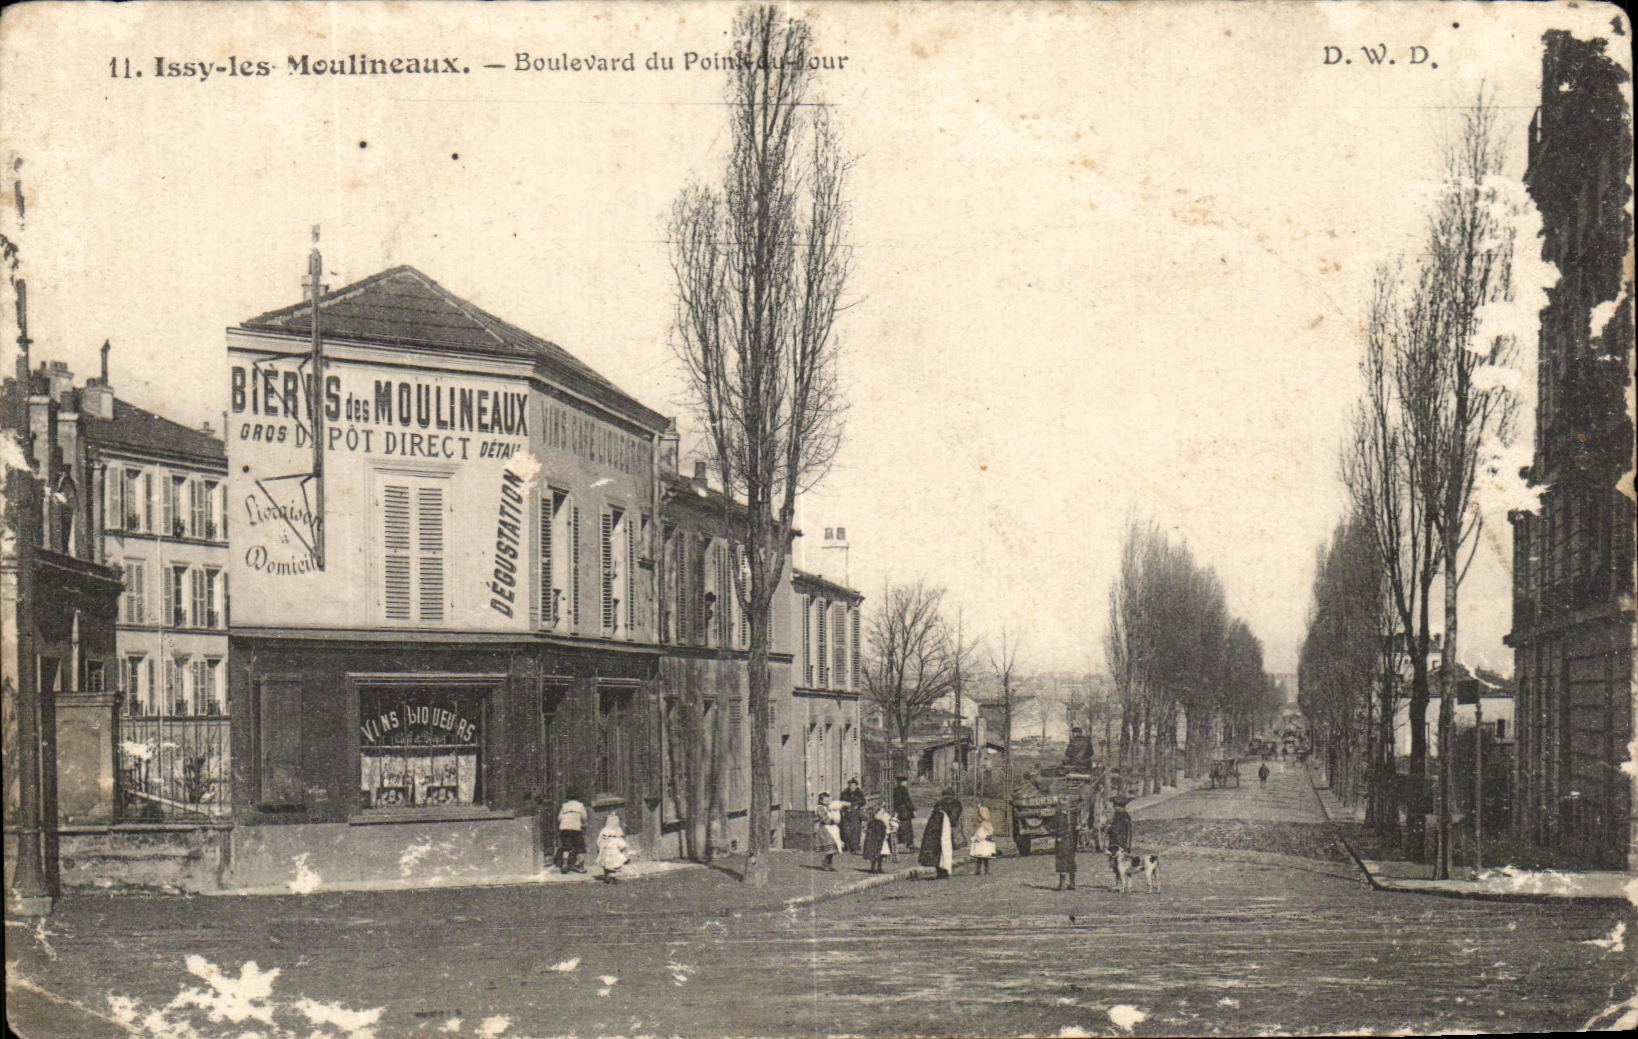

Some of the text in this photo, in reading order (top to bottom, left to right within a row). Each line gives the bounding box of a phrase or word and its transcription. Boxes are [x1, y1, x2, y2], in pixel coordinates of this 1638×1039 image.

[346, 392, 369, 422] des
[374, 379, 528, 437] MOULINEAUX
[240, 422, 287, 443] GROS
[296, 422, 374, 453] DPÔT
[384, 430, 470, 460] DIRECT
[490, 468, 525, 619] DÉGUSTATION
[360, 711, 399, 742] VINS
[406, 704, 476, 742] LIQUEURS
